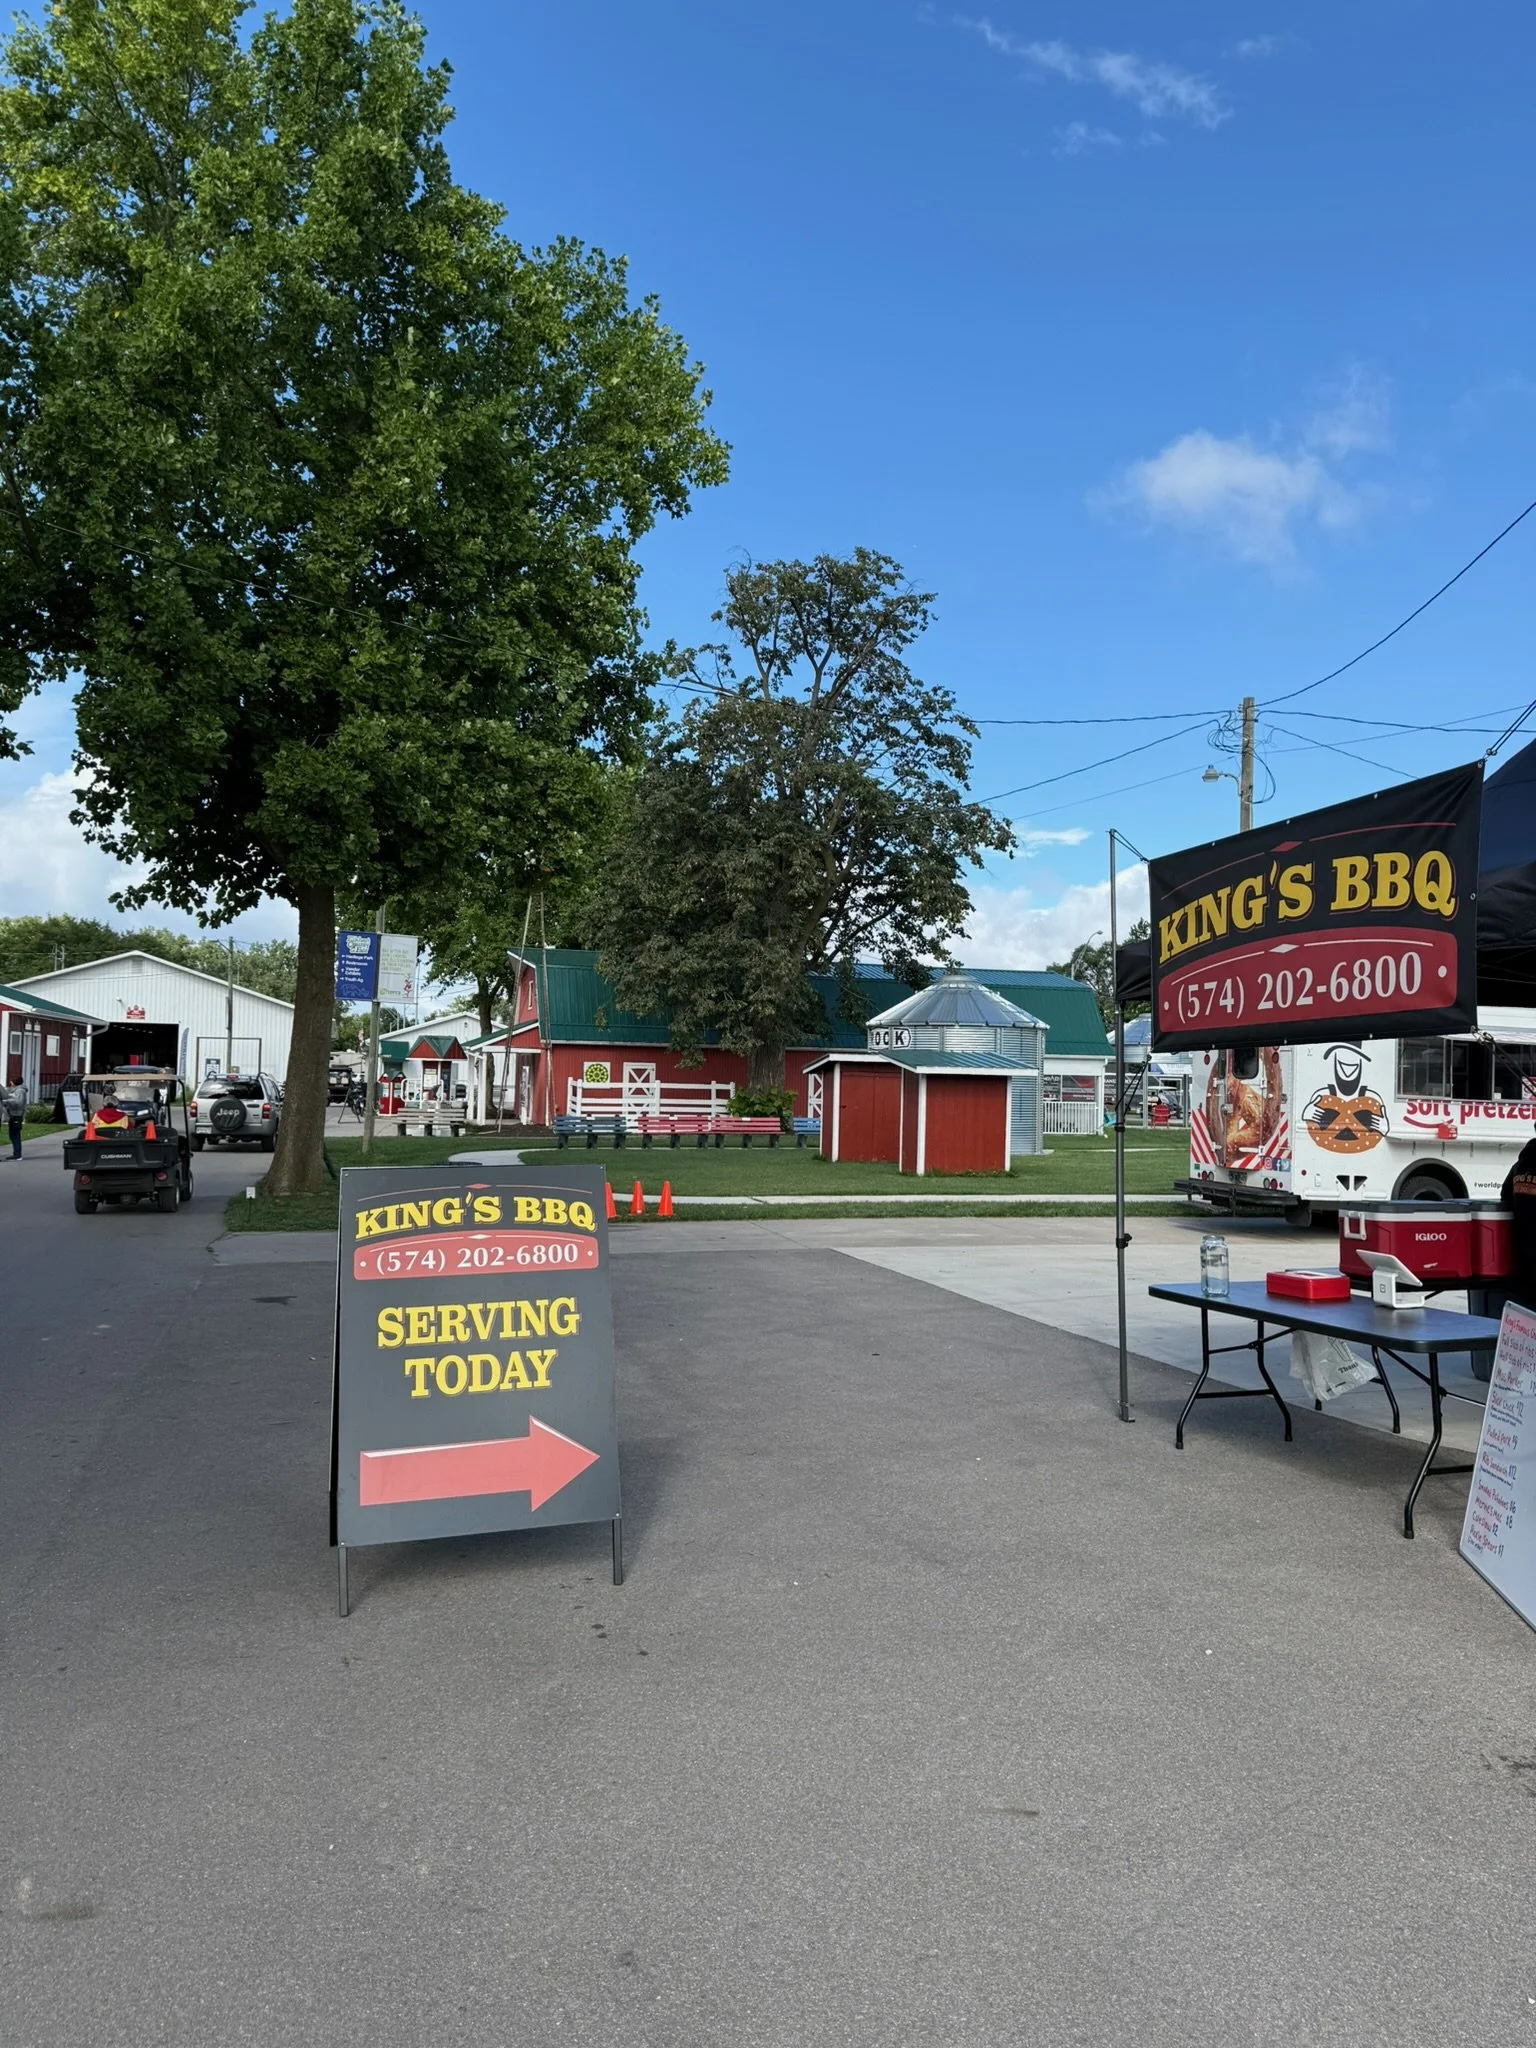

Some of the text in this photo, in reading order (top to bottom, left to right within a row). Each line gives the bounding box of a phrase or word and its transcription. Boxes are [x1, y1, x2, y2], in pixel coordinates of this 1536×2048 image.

[1158, 850, 1457, 965] KING'S BBQ
[1177, 951, 1422, 1024] (574) 202-6800
[217, 1108, 240, 1117] Jeep
[355, 1192, 598, 1239] KING'S BBQ
[1415, 1233, 1447, 1241] IGLOO
[376, 1242, 578, 1274] (574) 202-6800
[377, 1297, 580, 1348] SERVING
[404, 1348, 557, 1398] TODAY
